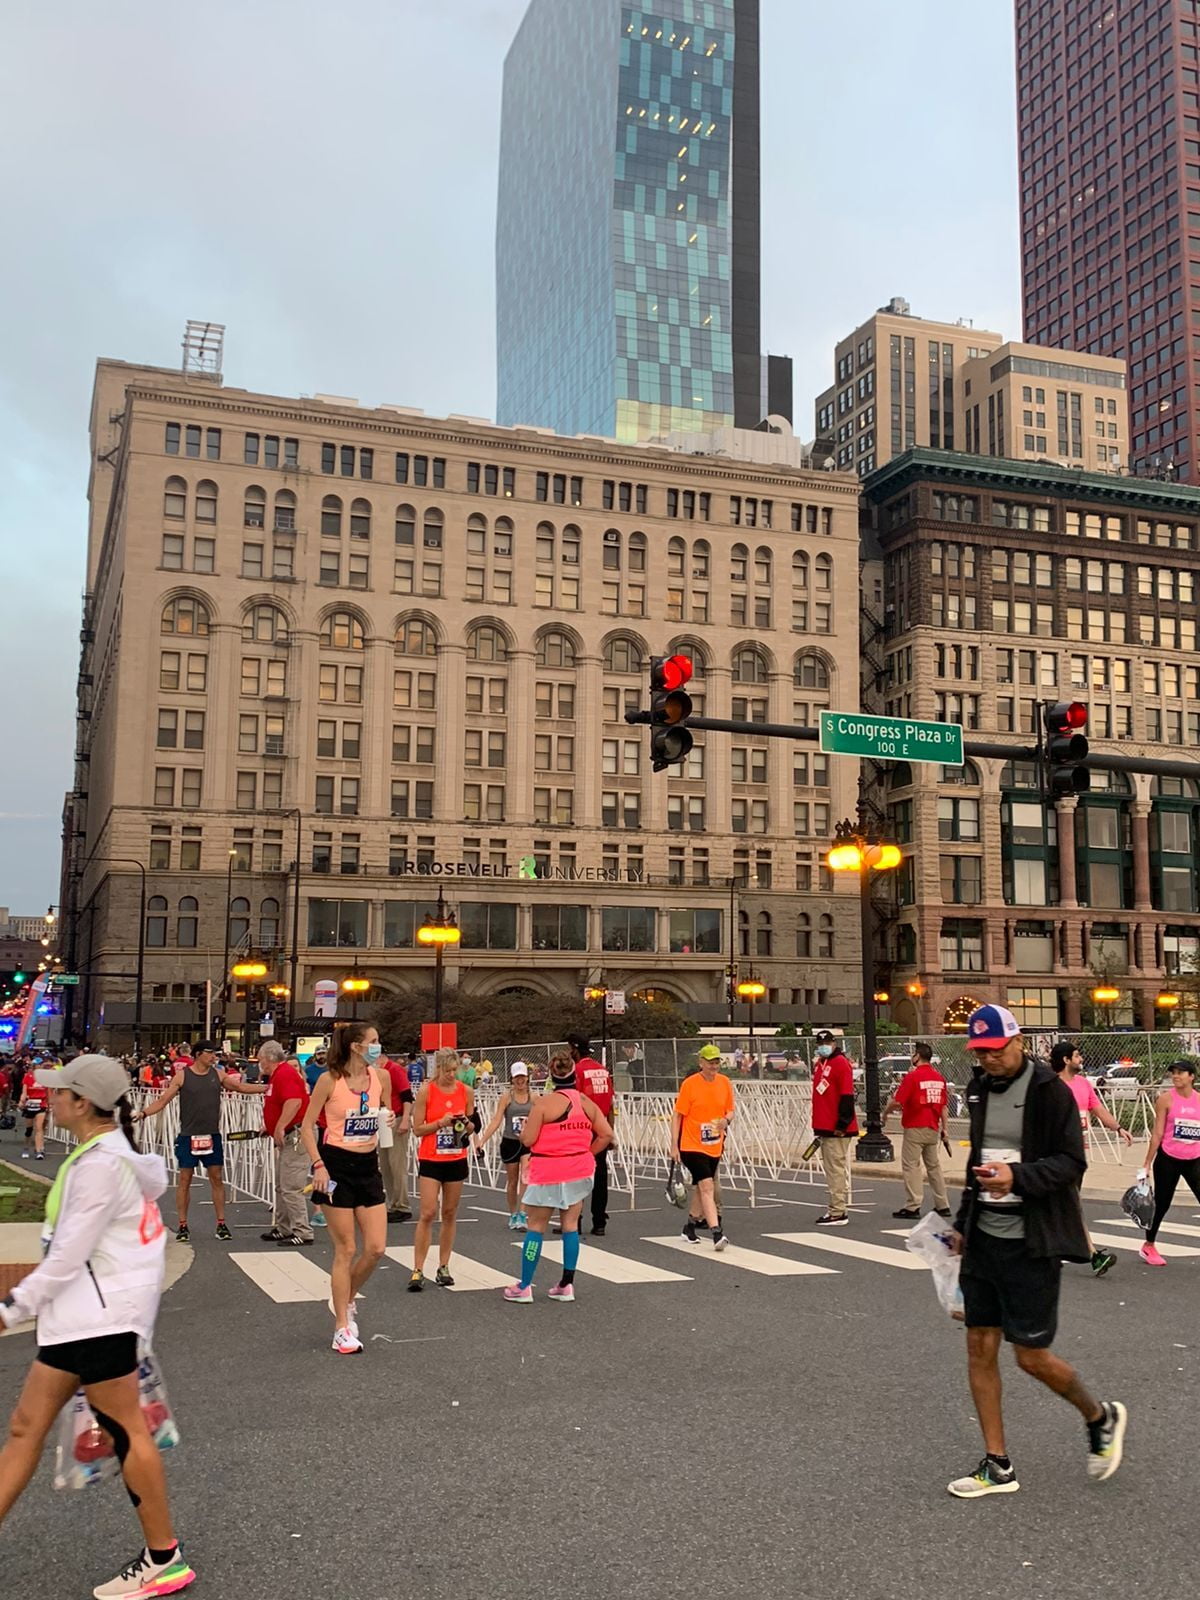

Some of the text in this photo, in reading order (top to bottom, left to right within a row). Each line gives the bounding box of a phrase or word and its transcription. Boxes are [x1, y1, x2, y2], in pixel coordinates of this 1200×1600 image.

[826, 718, 956, 743] S Congress Plaza Dr
[877, 742, 909, 755] 100 E
[404, 861, 512, 878] ROOSEVELT
[541, 866, 643, 882] UNIVERSITY
[346, 1119, 353, 1130] F
[1175, 1126, 1181, 1134] F
[437, 1135, 453, 1144] F 33
